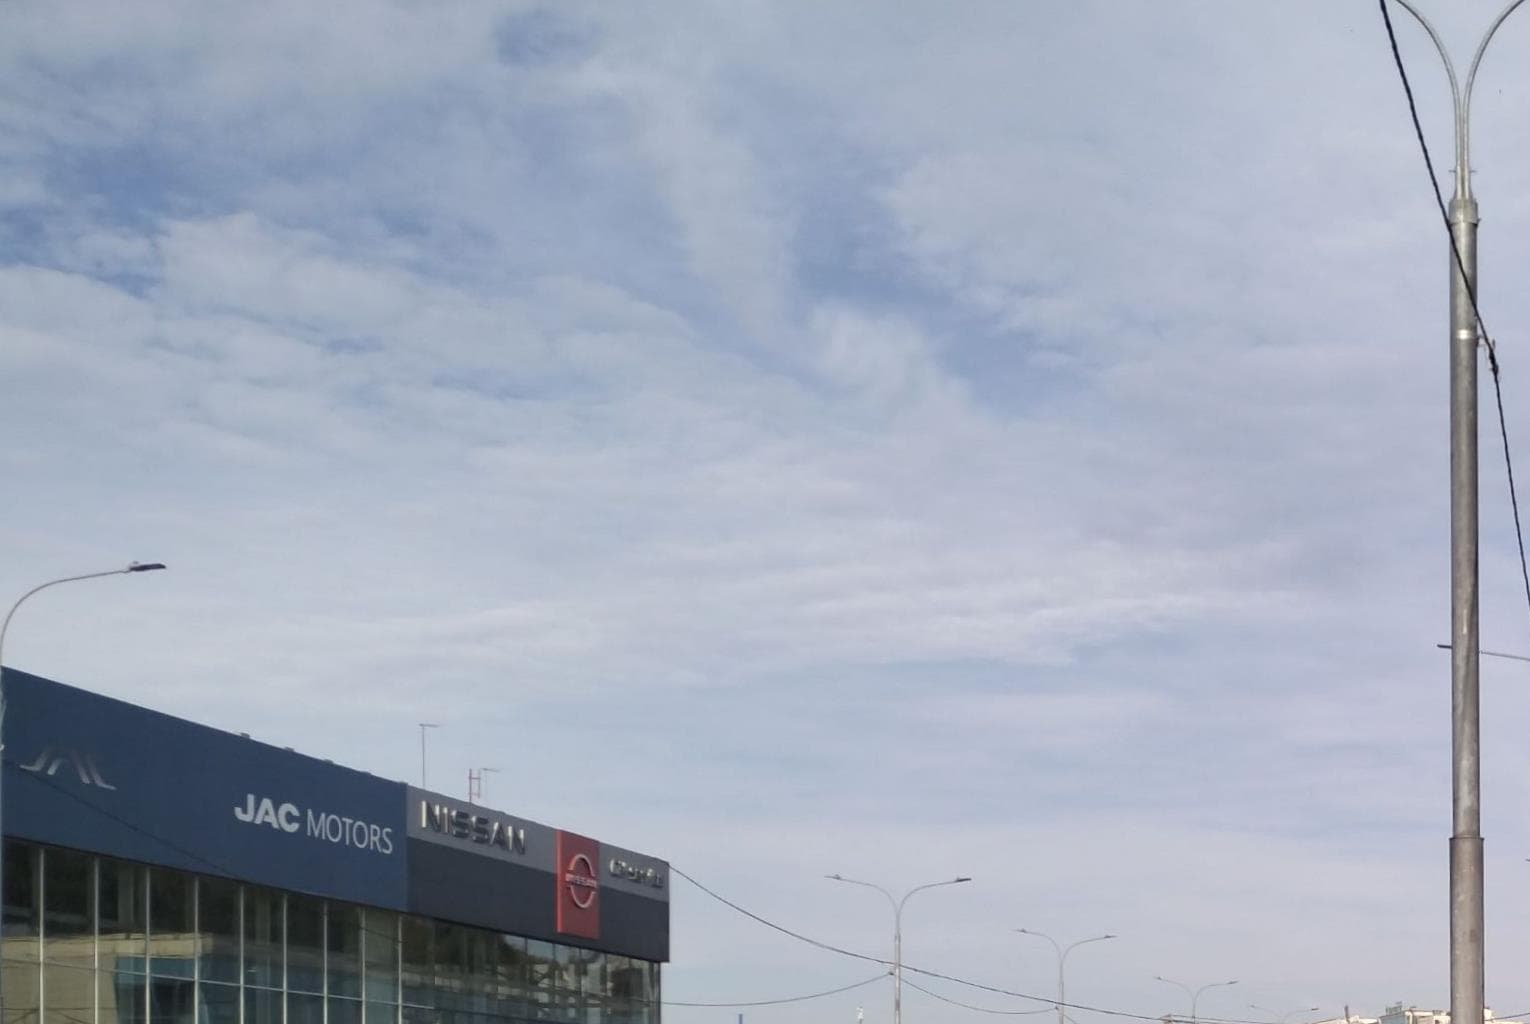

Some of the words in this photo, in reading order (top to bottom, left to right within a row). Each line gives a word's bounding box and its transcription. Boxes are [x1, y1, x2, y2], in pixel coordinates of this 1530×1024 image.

[235, 794, 300, 833] JAC
[306, 808, 393, 854] MOTORS
[421, 800, 526, 856] NISSAN
